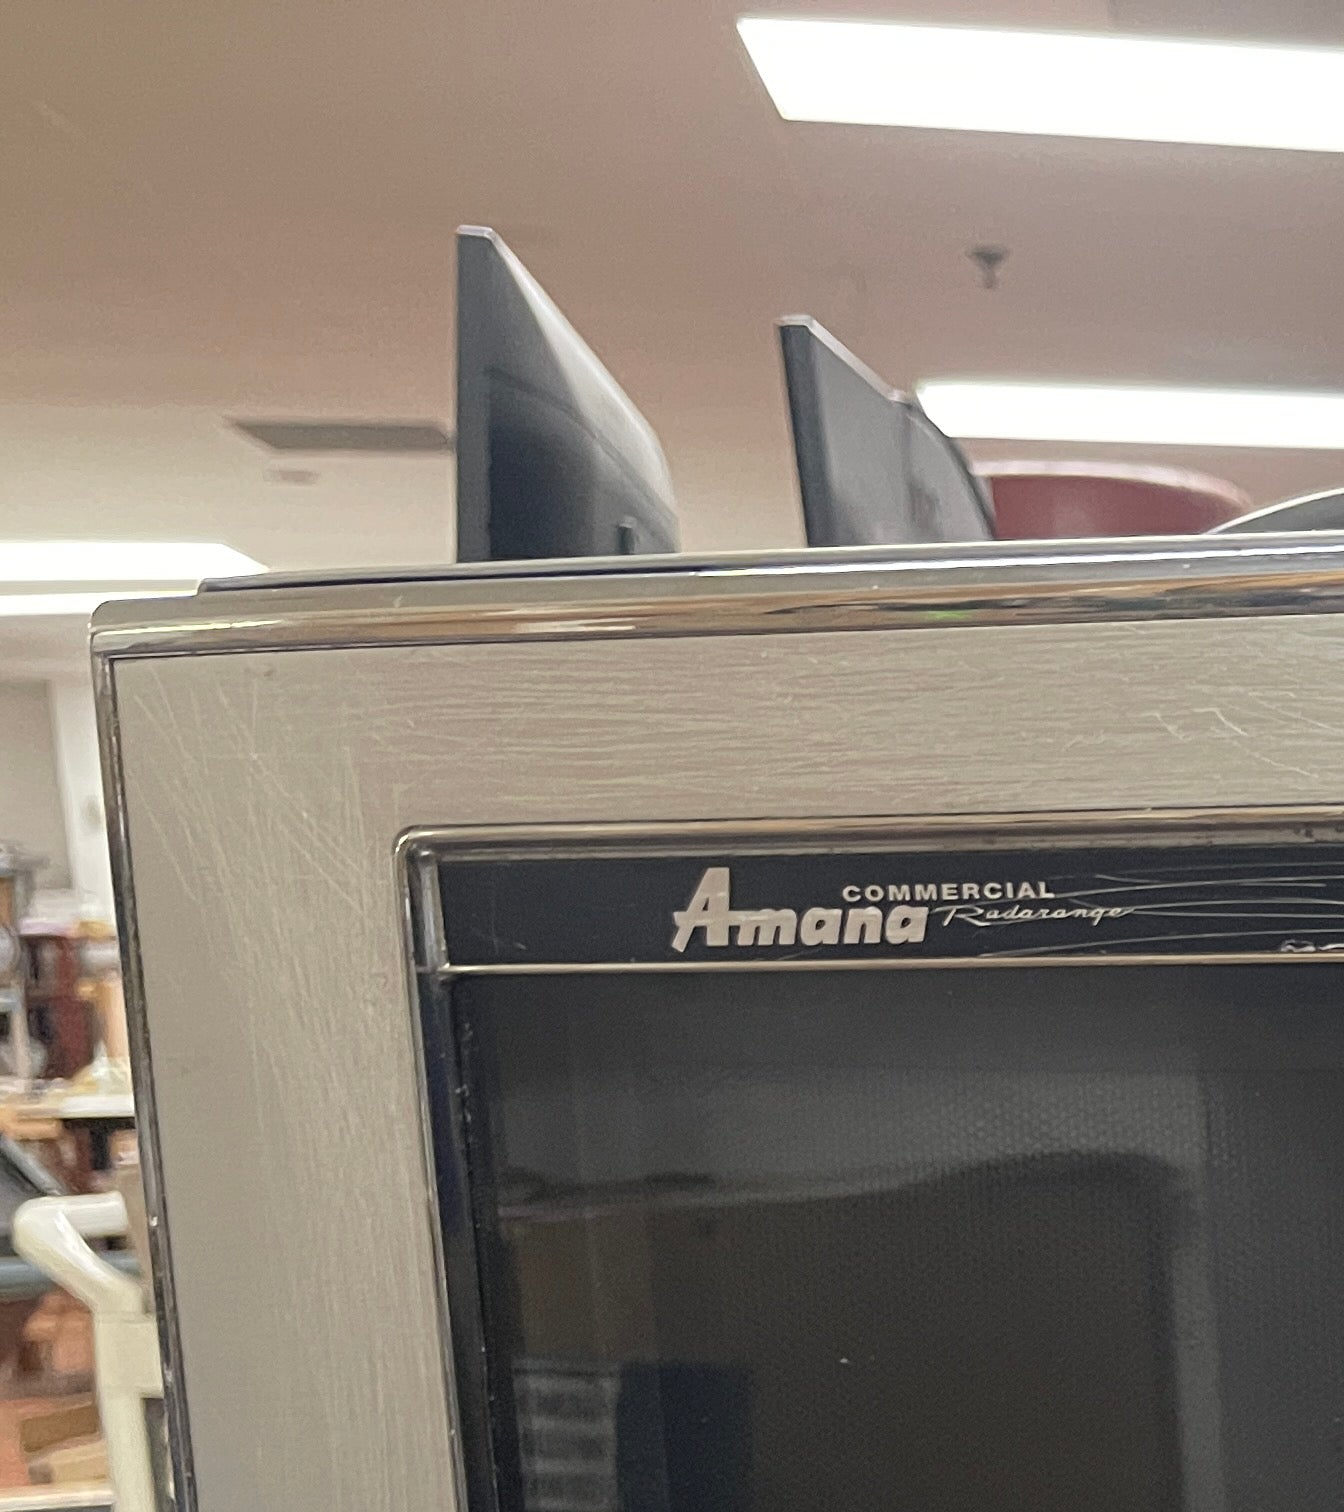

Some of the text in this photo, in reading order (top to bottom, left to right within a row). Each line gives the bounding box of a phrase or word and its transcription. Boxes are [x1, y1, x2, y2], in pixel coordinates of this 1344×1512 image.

[842, 881, 1056, 902] COMMERCIAL
[671, 867, 931, 953] Amana
[941, 903, 1130, 928] Radarange
